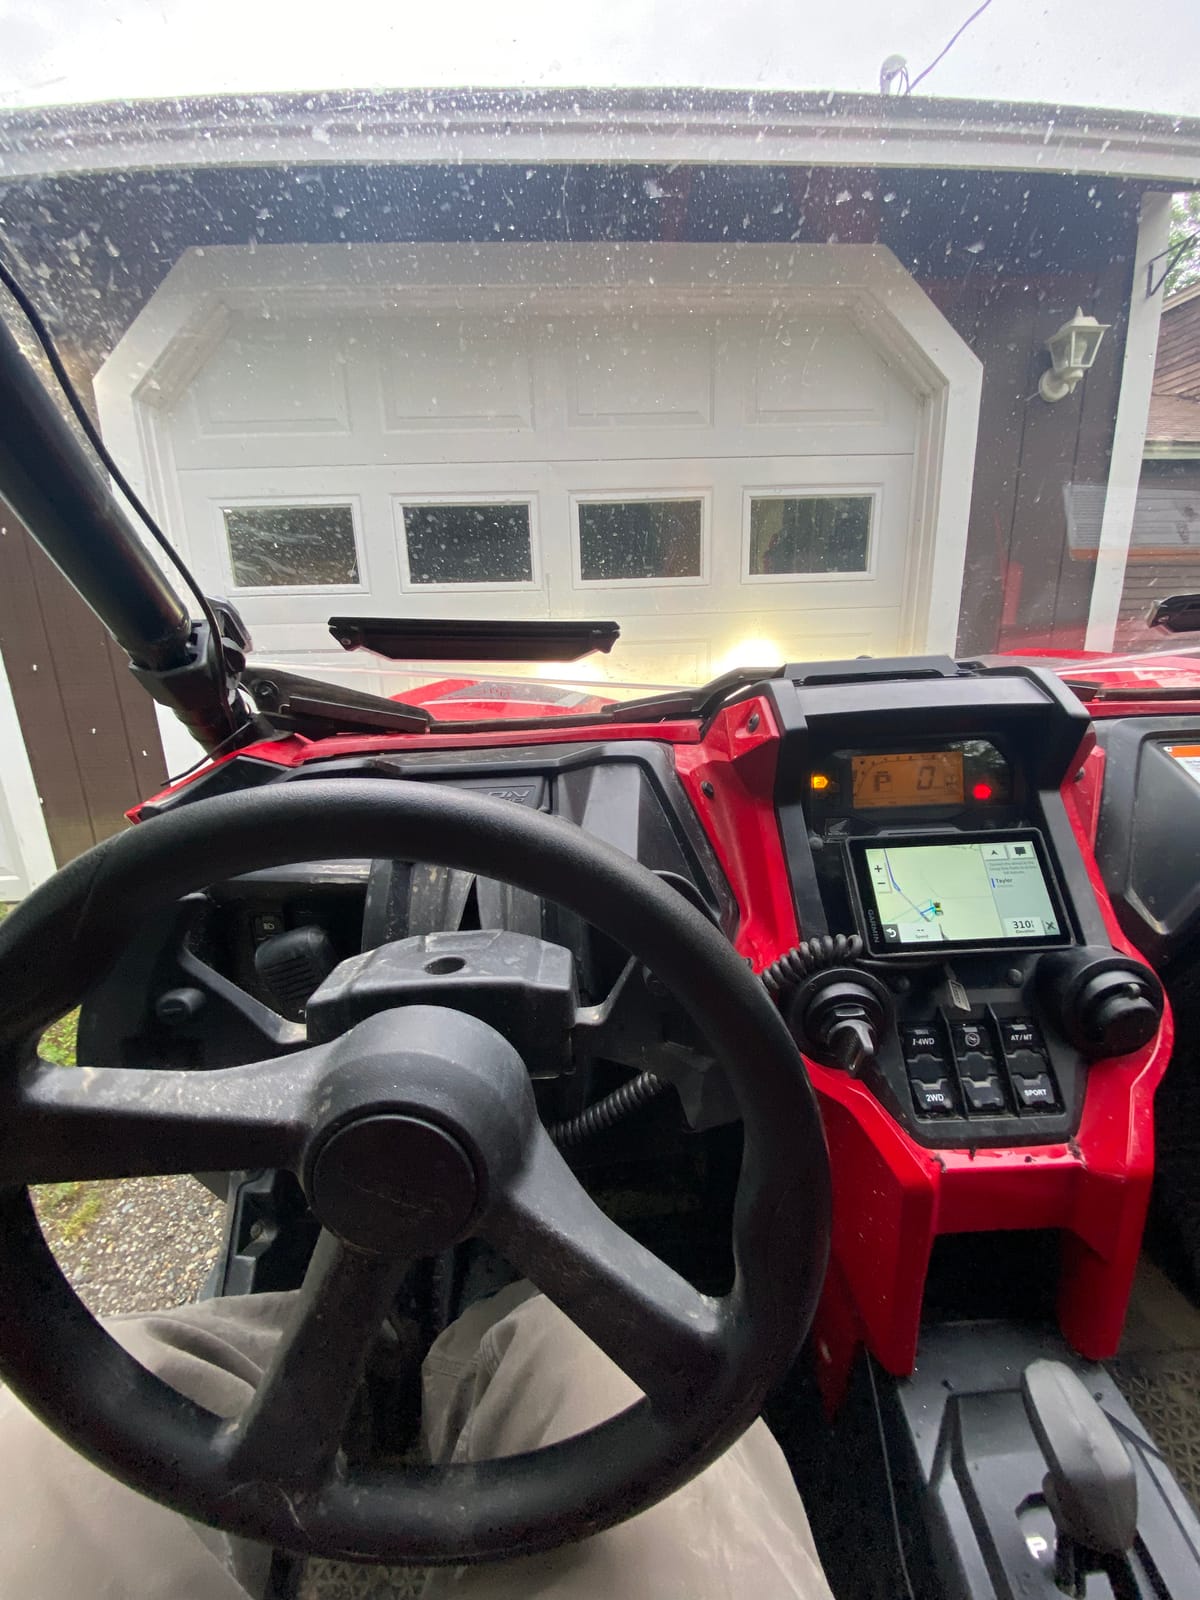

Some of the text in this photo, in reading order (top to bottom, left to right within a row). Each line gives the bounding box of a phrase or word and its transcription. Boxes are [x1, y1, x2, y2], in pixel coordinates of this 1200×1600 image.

[873, 771, 892, 793] P
[867, 909, 880, 943] GARMIN
[925, 1093, 944, 1102] 2WD
[1023, 1088, 1047, 1097] SPORT
[1026, 1536, 1048, 1559] P
